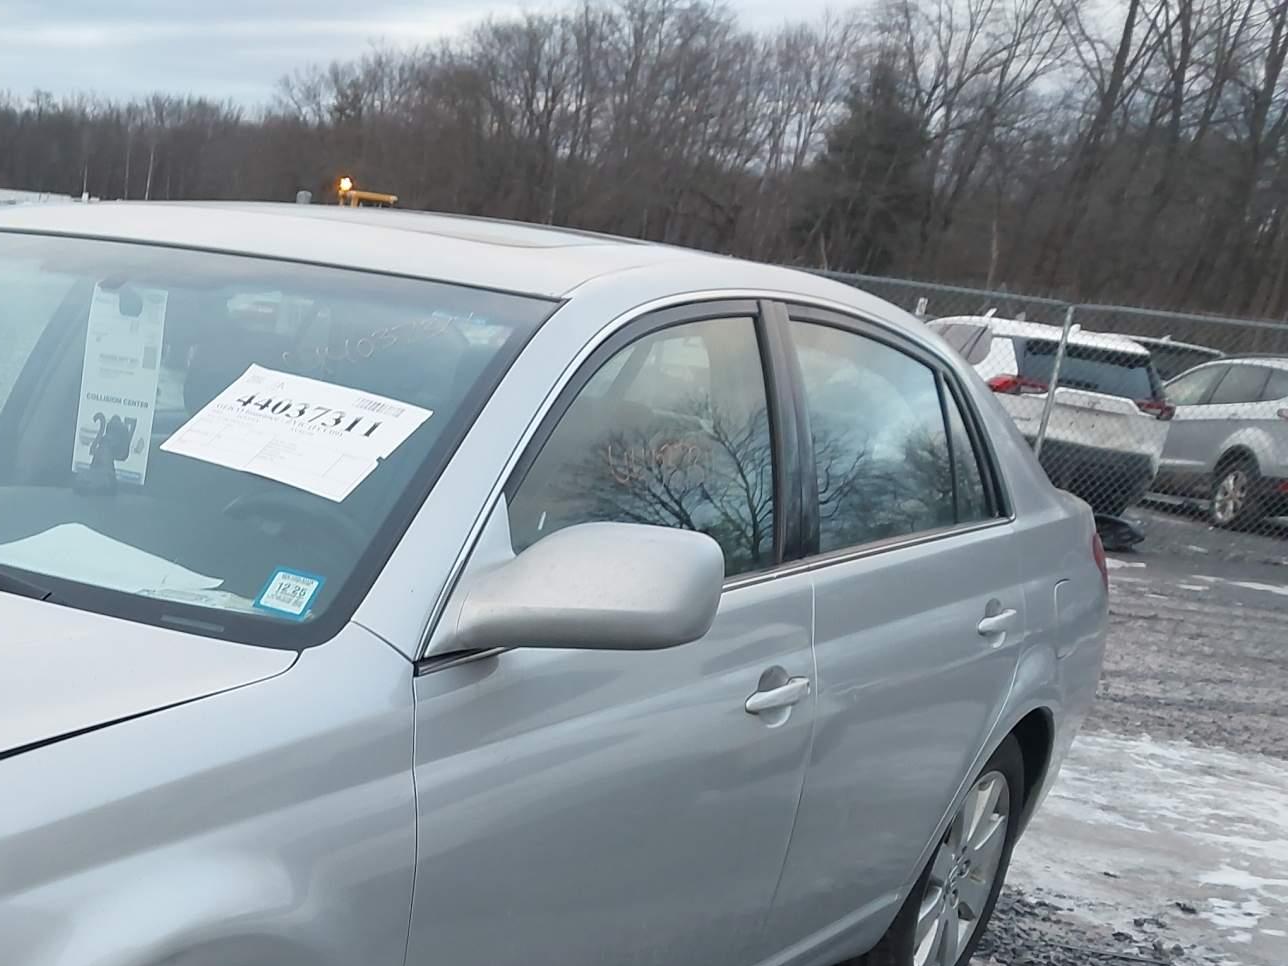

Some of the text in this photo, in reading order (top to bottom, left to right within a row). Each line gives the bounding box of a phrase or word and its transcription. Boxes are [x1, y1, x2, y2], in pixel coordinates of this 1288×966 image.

[86, 392, 149, 408] COLLISION CENTER
[236, 394, 383, 437] 44037311
